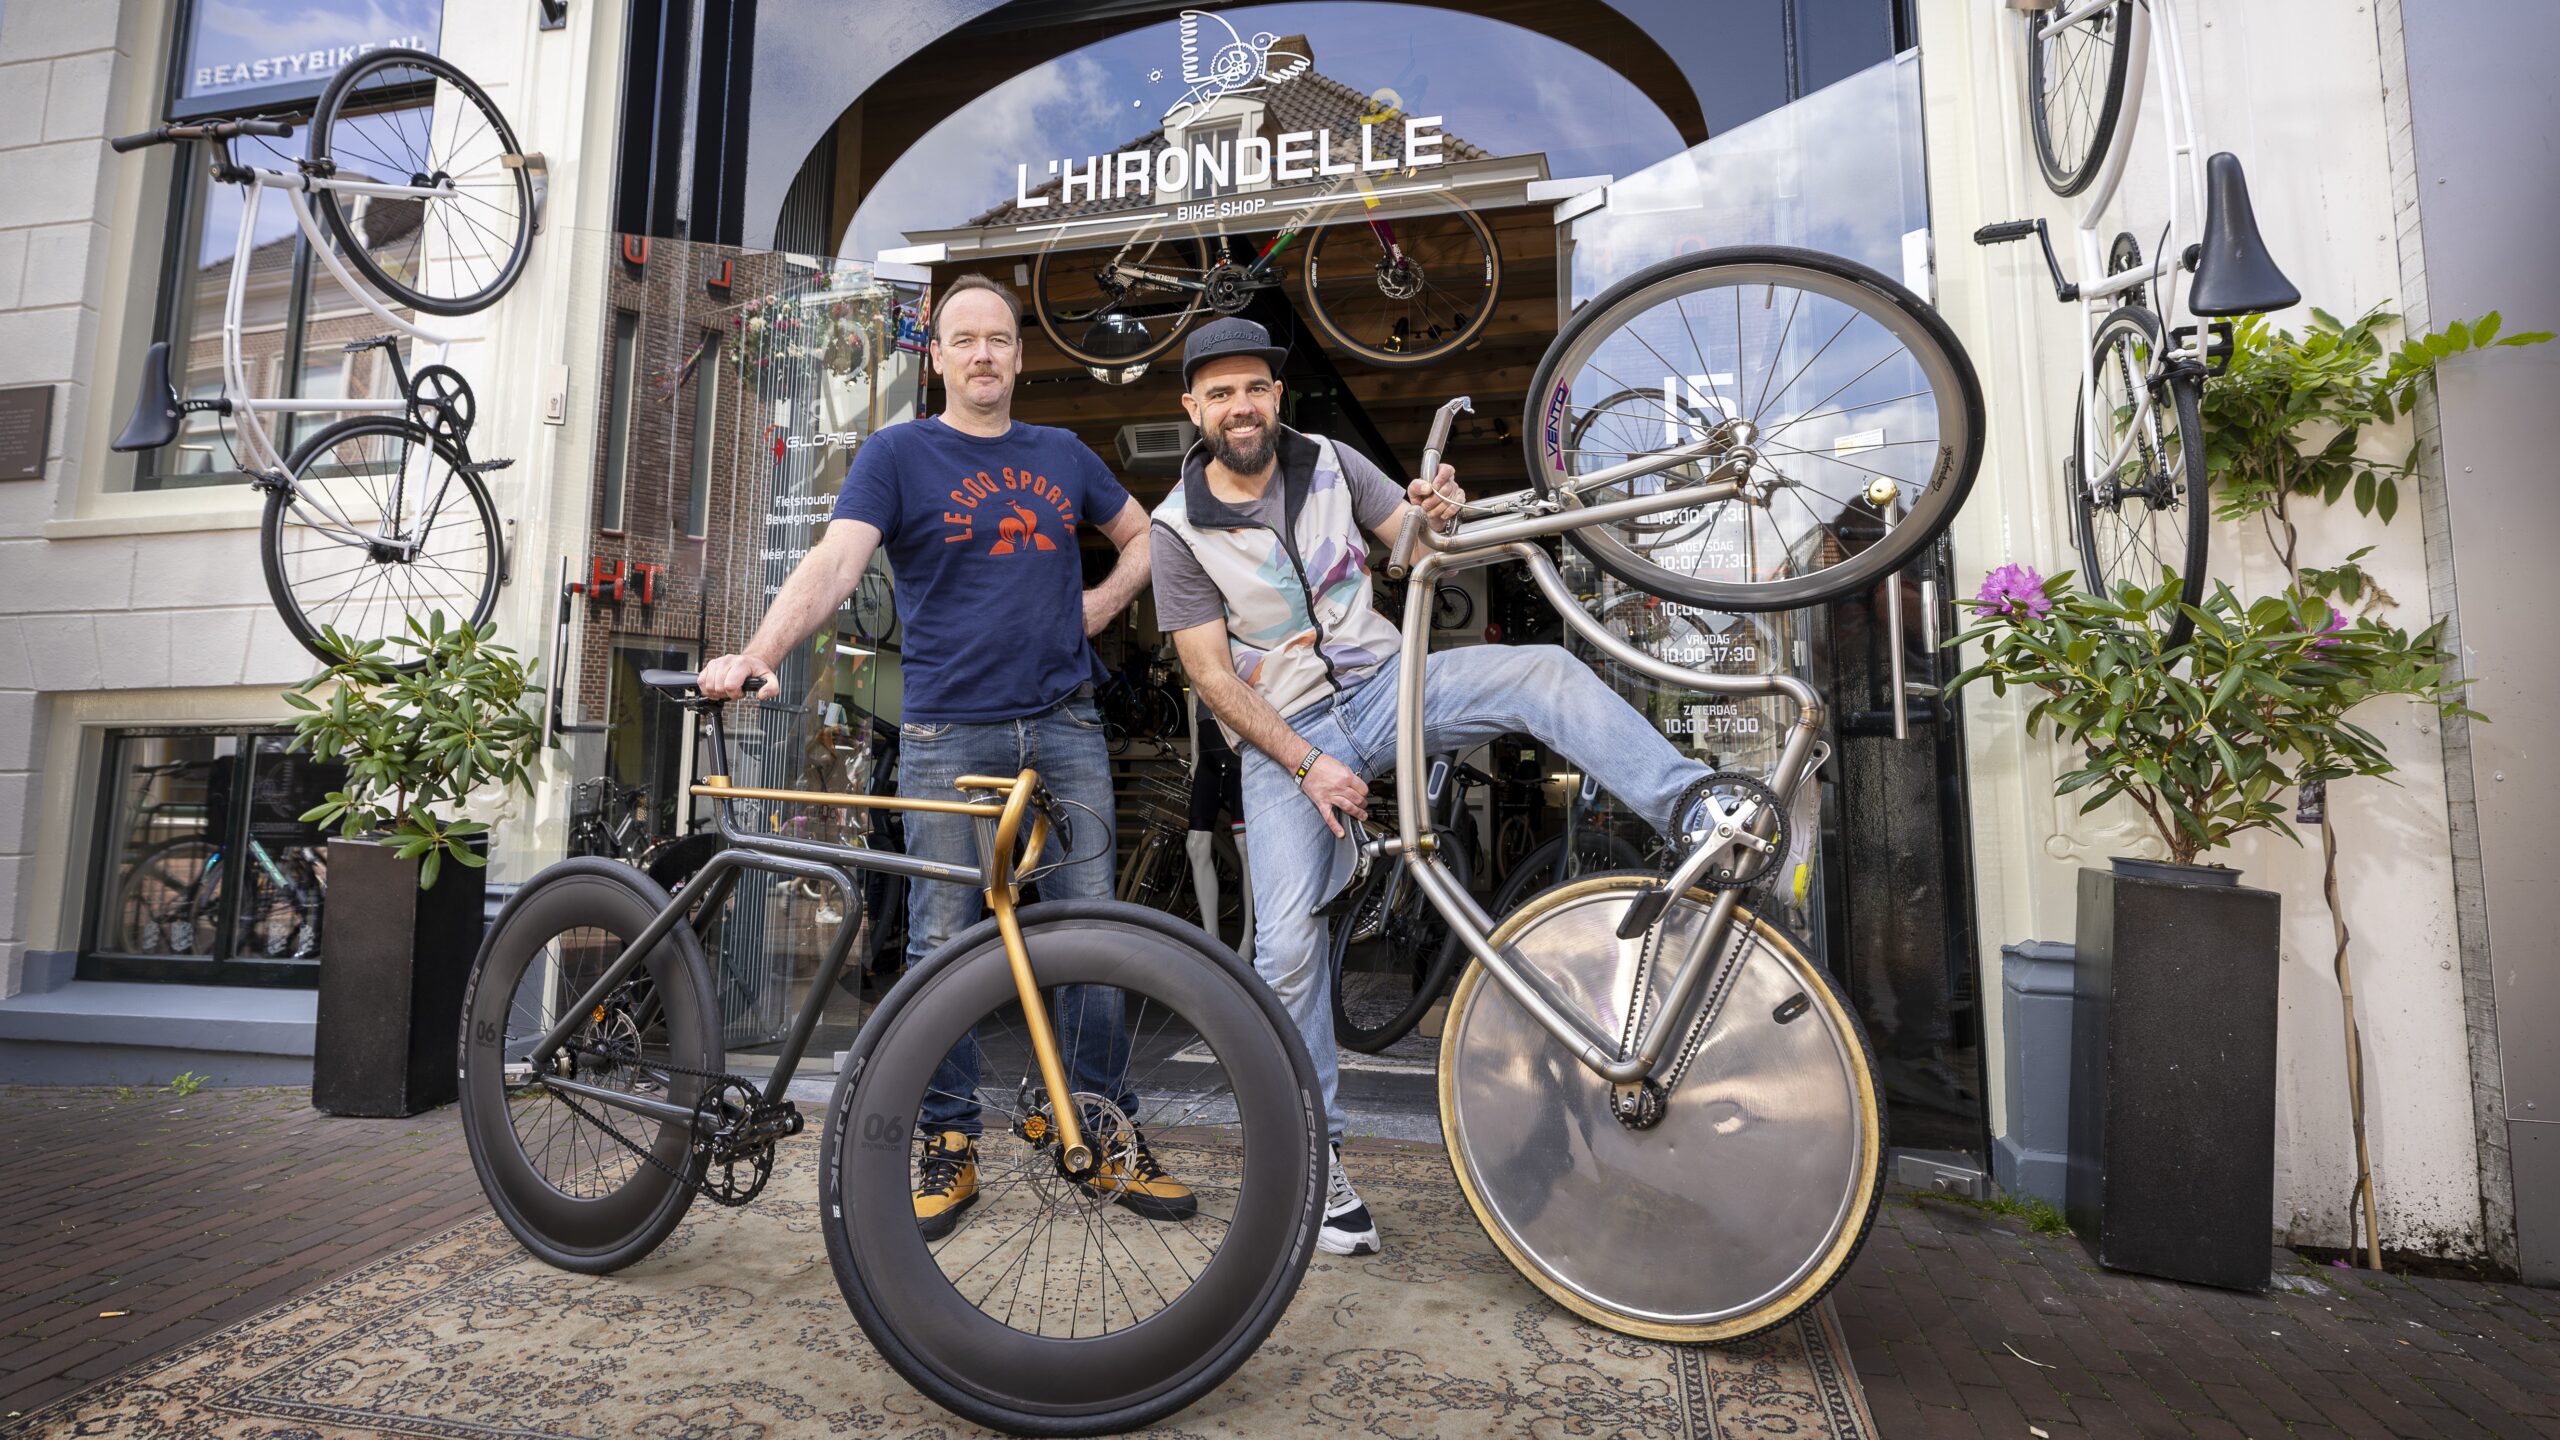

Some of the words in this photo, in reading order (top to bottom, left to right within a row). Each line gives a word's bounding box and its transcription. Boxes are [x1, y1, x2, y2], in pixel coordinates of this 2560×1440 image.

[194, 36, 427, 86] BEASTYBIKENL
[1016, 115, 1444, 209] L'HIRONDELLE
[1177, 204, 1216, 222] BIKE
[1220, 199, 1266, 219] SHOP
[1547, 386, 1567, 458] VENTO
[1663, 372, 1738, 445] 15
[786, 431, 858, 449] GLORIE
[775, 492, 840, 508] Fietshoudin
[950, 471, 1000, 509] COQ
[1002, 466, 1076, 537] SPORTIF
[943, 511, 973, 543] LE
[1674, 540, 1734, 554] WOENSDAG
[1659, 553, 1751, 571] 10:00-17:30
[1686, 633, 1731, 646] VRIJDAG
[1661, 646, 1756, 664] 10:00-17:30
[1683, 704, 1738, 717] ZATERDAG
[1663, 717, 1760, 735] 10:00-17:00
[476, 1020, 497, 1043] 06
[830, 1056, 867, 1194] KOJAK
[863, 1112, 905, 1144] 06
[1289, 1088, 1318, 1267] SCHWALBE
